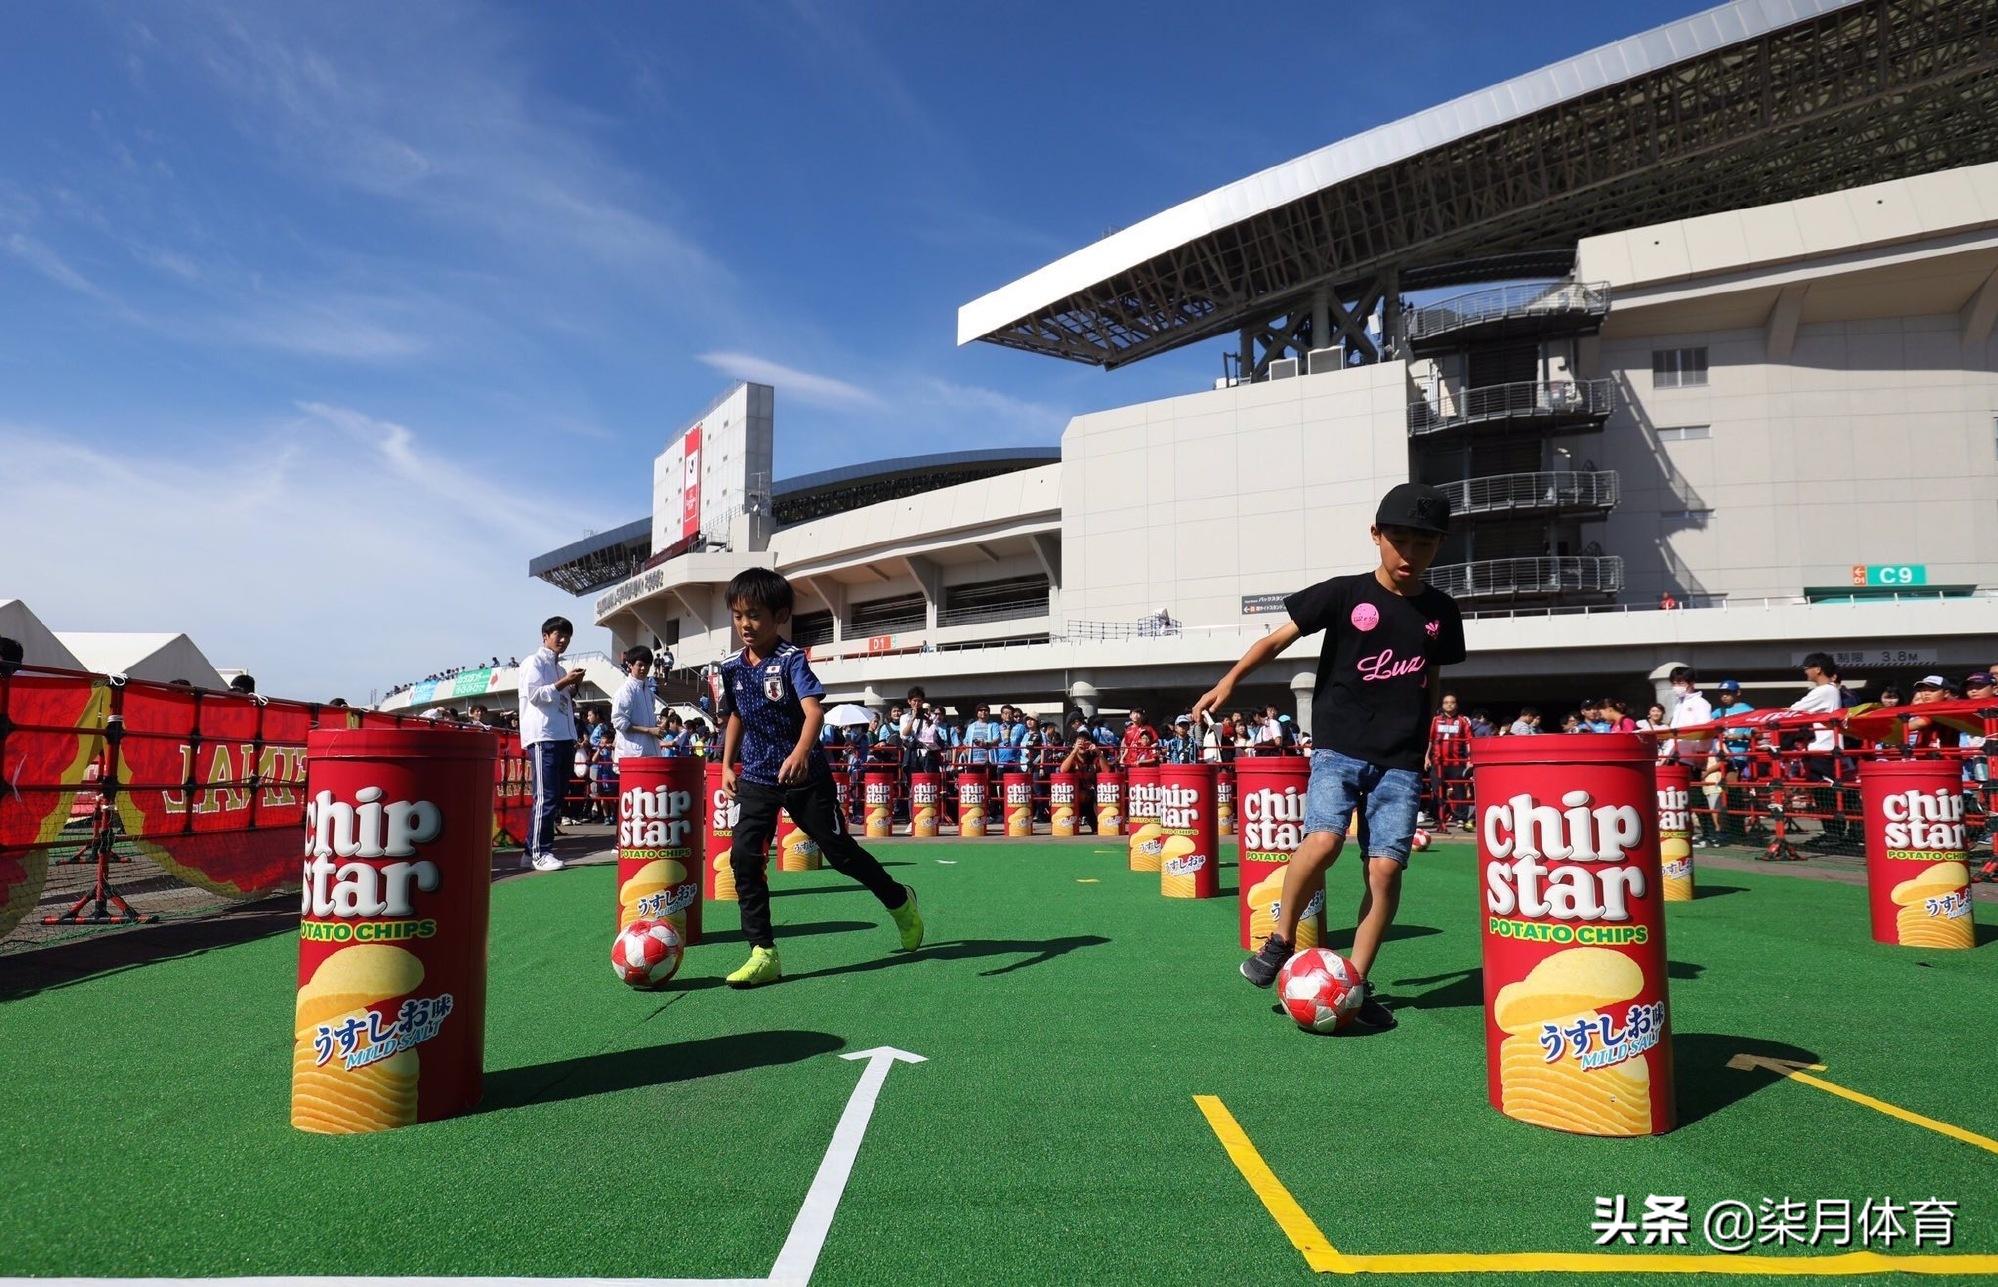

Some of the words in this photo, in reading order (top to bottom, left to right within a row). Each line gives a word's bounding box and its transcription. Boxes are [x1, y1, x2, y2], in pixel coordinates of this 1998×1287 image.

[1879, 567, 1913, 583] C9
[873, 637, 885, 650] D1
[1837, 652, 1864, 663] 制限
[1357, 649, 1426, 681] Luz
[867, 783, 890, 794] chip
[914, 783, 937, 794] chip
[960, 783, 985, 794] chip
[1007, 783, 1031, 794] chip
[1051, 783, 1074, 794] chip
[1096, 783, 1119, 794] chip
[867, 793, 890, 804] star
[914, 793, 937, 804] star
[960, 793, 985, 804] star
[1007, 793, 1031, 804] star
[1051, 793, 1074, 804] star
[1096, 793, 1119, 804] star
[1161, 784, 1198, 807] hip
[621, 785, 692, 819] chip
[1161, 807, 1198, 828] tar
[620, 816, 692, 848] star
[1484, 790, 1642, 862] chip
[1246, 851, 1289, 862] POTATO
[1888, 851, 1943, 860] POTATO
[1486, 854, 1645, 921] star
[301, 922, 352, 942] OTATO
[354, 919, 438, 943] CHIPS
[1490, 918, 1574, 943] POTATO
[1577, 925, 1648, 944] CHIPS
[313, 993, 454, 1068] うすしお味
[1540, 1001, 1665, 1063] うすしお味
[346, 1039, 398, 1071] MILD
[397, 1019, 443, 1052] SALT
[1581, 1044, 1628, 1071] MILD
[1628, 1027, 1661, 1056] SALT
